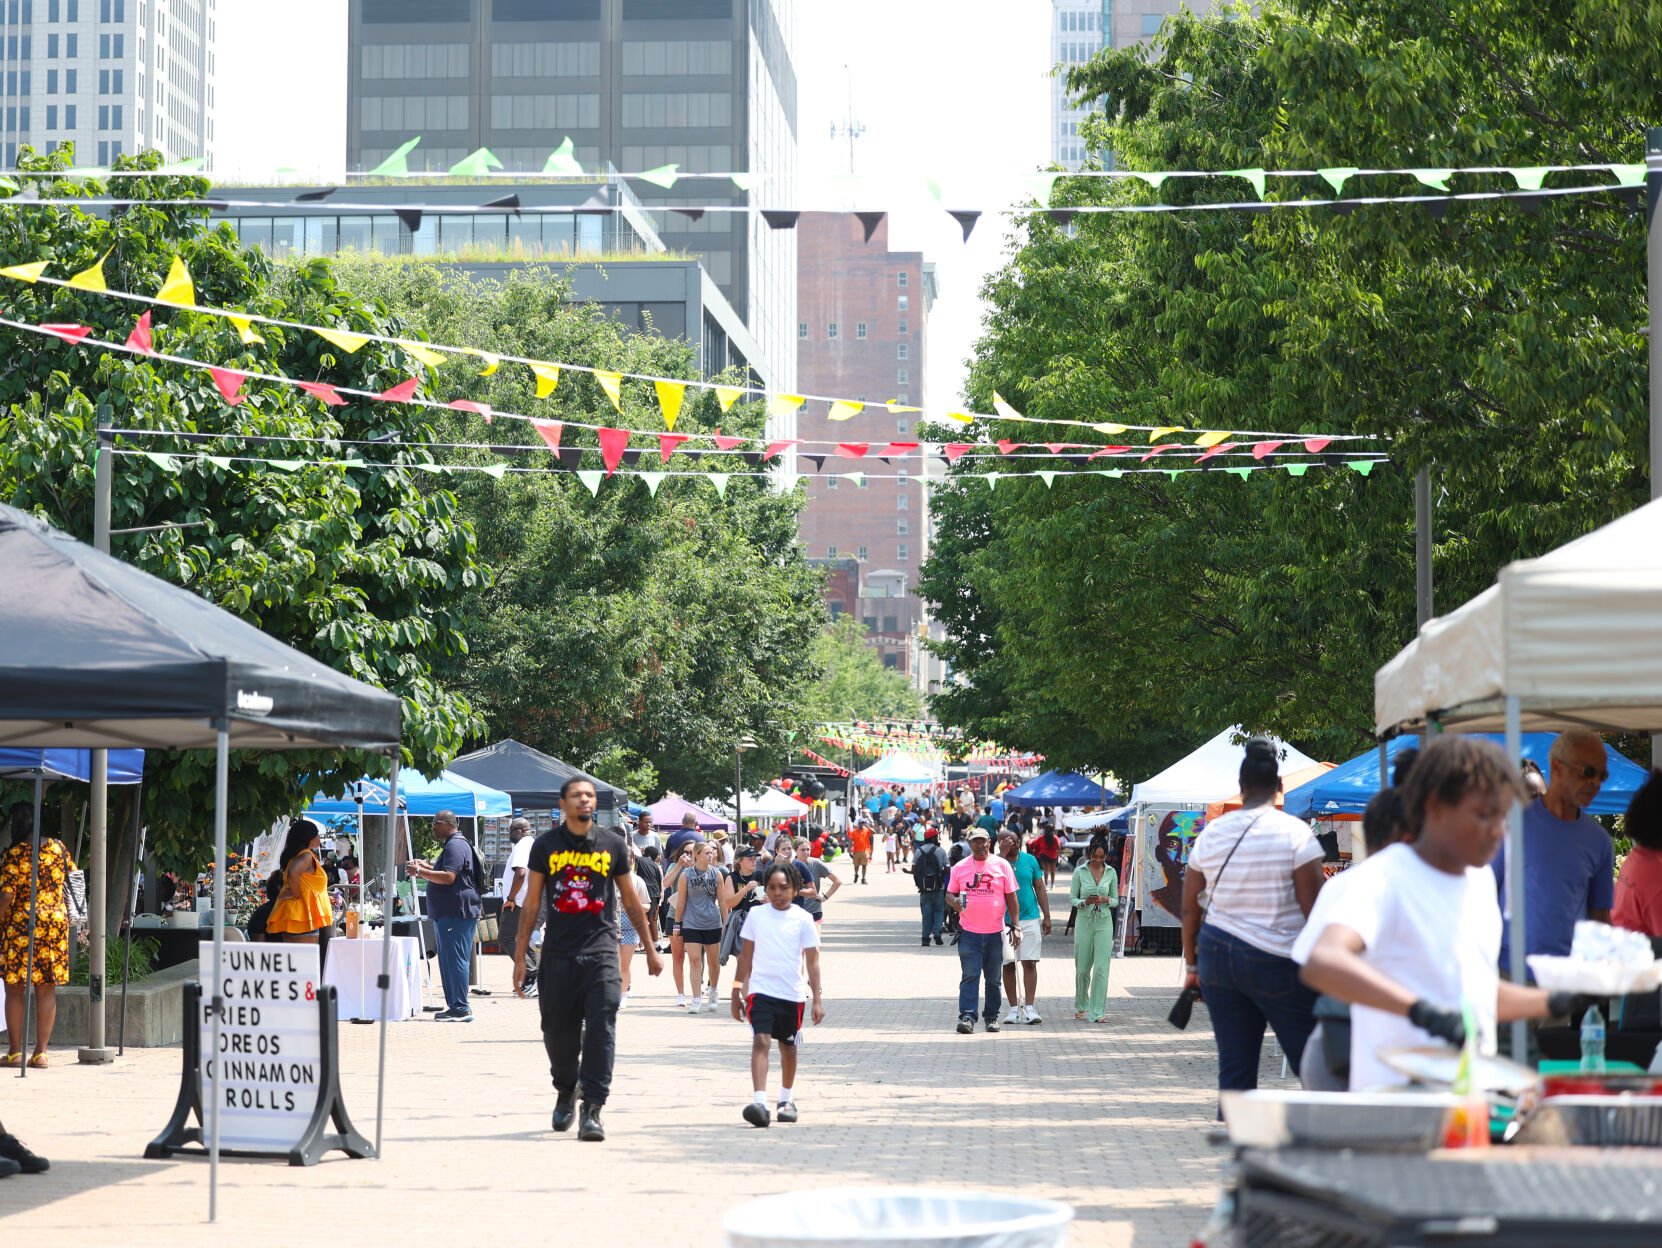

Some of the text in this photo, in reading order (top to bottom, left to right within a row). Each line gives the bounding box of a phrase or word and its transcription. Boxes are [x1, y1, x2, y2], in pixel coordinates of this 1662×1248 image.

[549, 850, 611, 877] SAVAGE
[223, 978, 298, 1000] CAKES
[220, 1033, 280, 1055] OREOS
[226, 1088, 295, 1111] ROLLS
